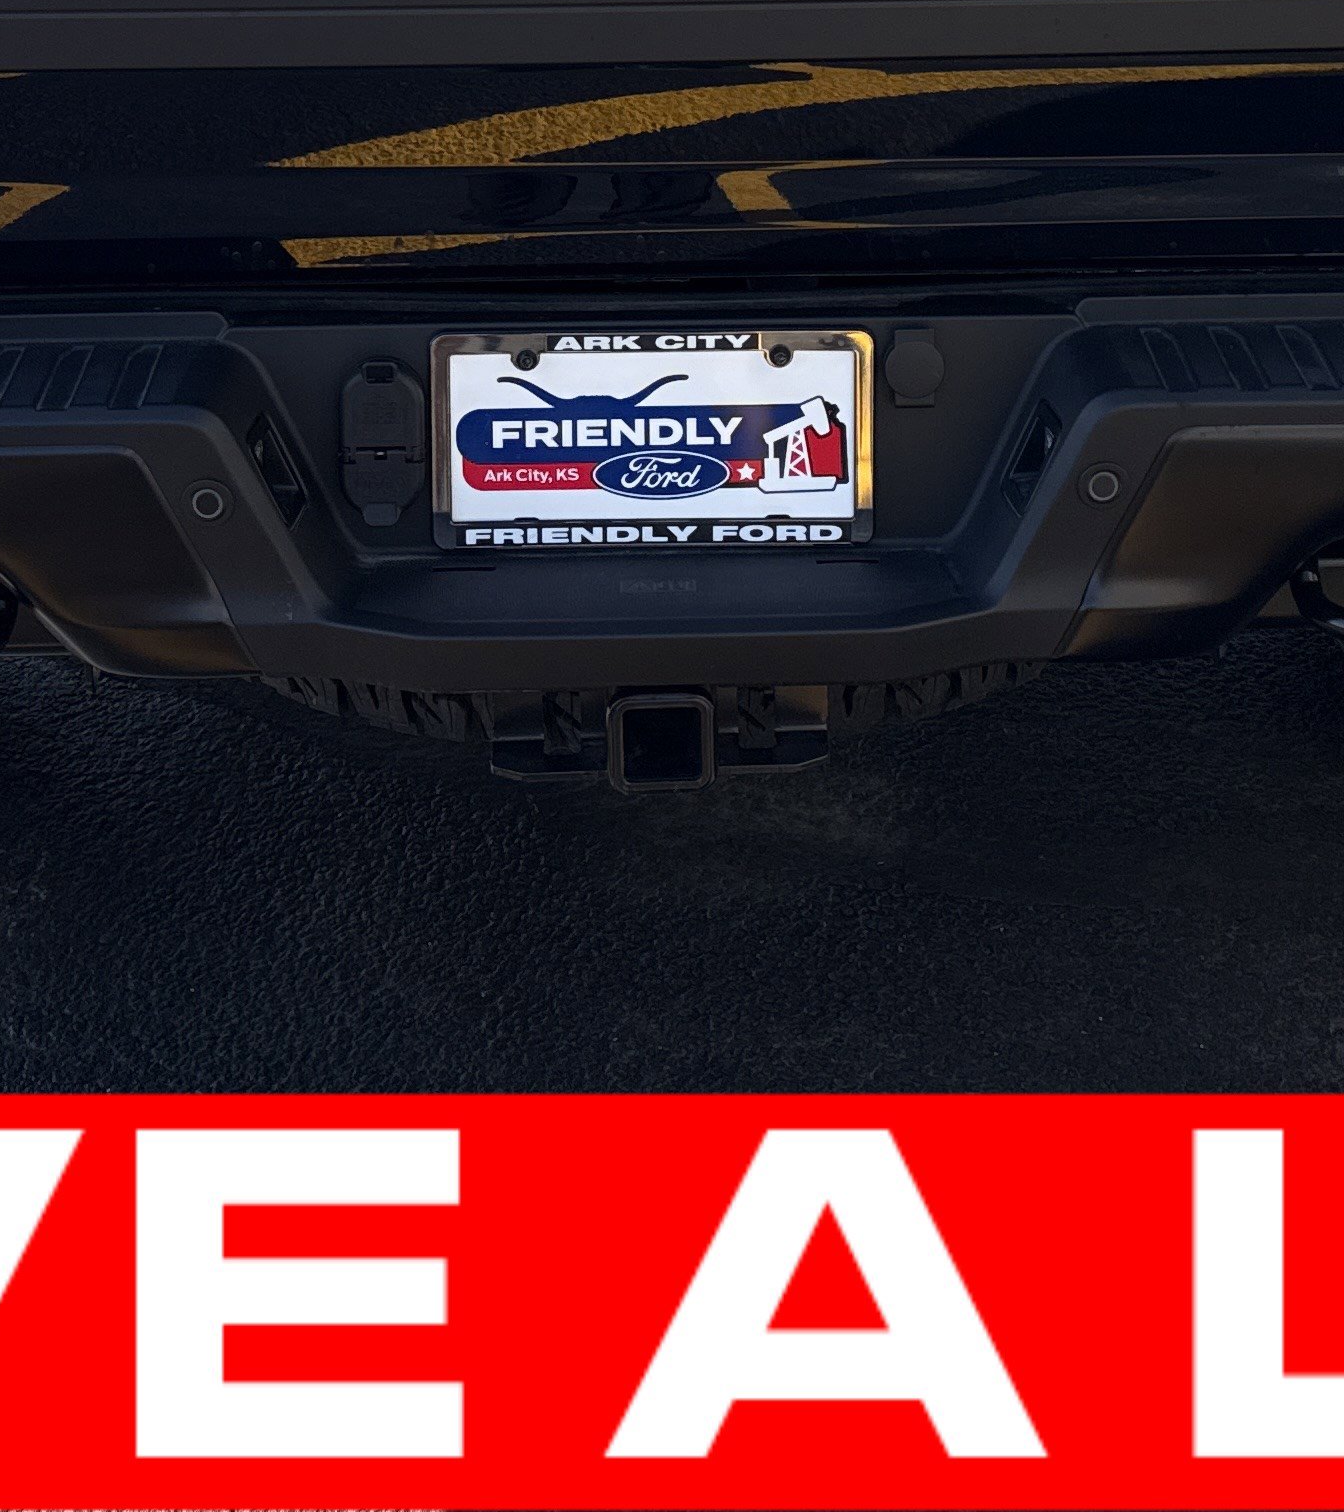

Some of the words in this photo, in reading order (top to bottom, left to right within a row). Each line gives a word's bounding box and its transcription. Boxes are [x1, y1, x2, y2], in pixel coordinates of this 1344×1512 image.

[554, 335, 642, 351] ARK
[655, 333, 752, 349] CITY
[491, 416, 744, 449] FRIENDLY
[484, 468, 513, 483] Ark
[515, 467, 553, 485] City,
[556, 467, 580, 482] KS
[620, 456, 701, 489] Ford
[465, 526, 695, 546] FRIENDLY
[712, 524, 843, 543] FORD
